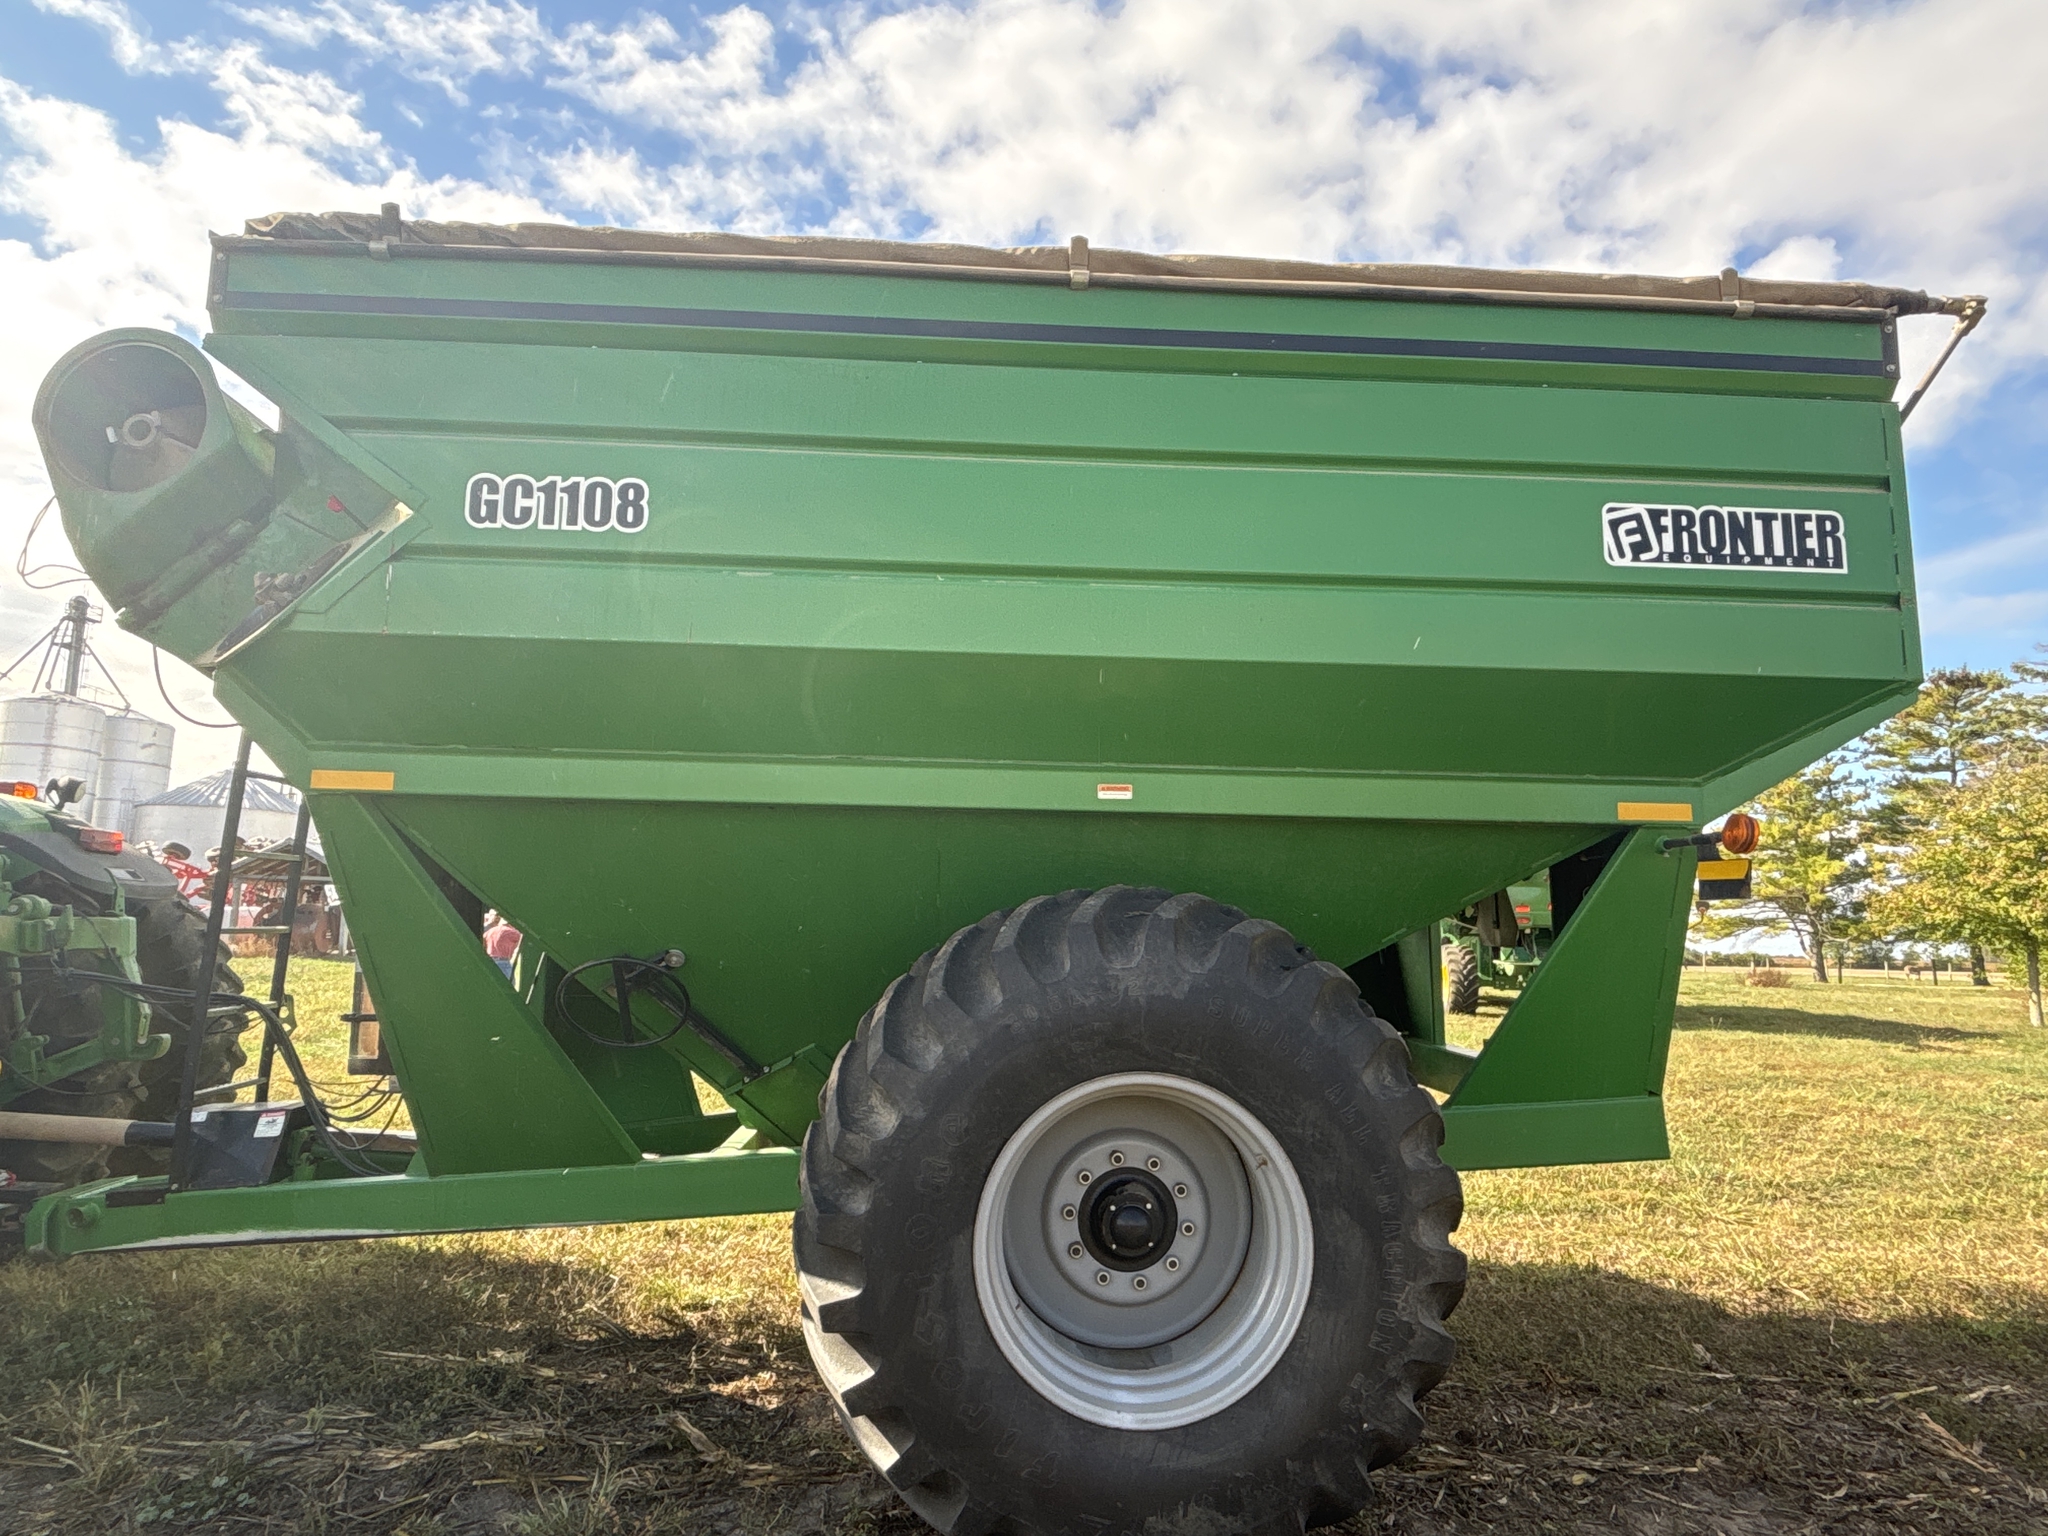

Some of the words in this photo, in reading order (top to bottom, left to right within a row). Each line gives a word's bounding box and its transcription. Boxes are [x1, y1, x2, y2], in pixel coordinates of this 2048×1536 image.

[465, 473, 648, 532] GC1108
[1648, 508, 1843, 561] FRONTIER
[1662, 552, 1835, 567] EQUIPMENT
